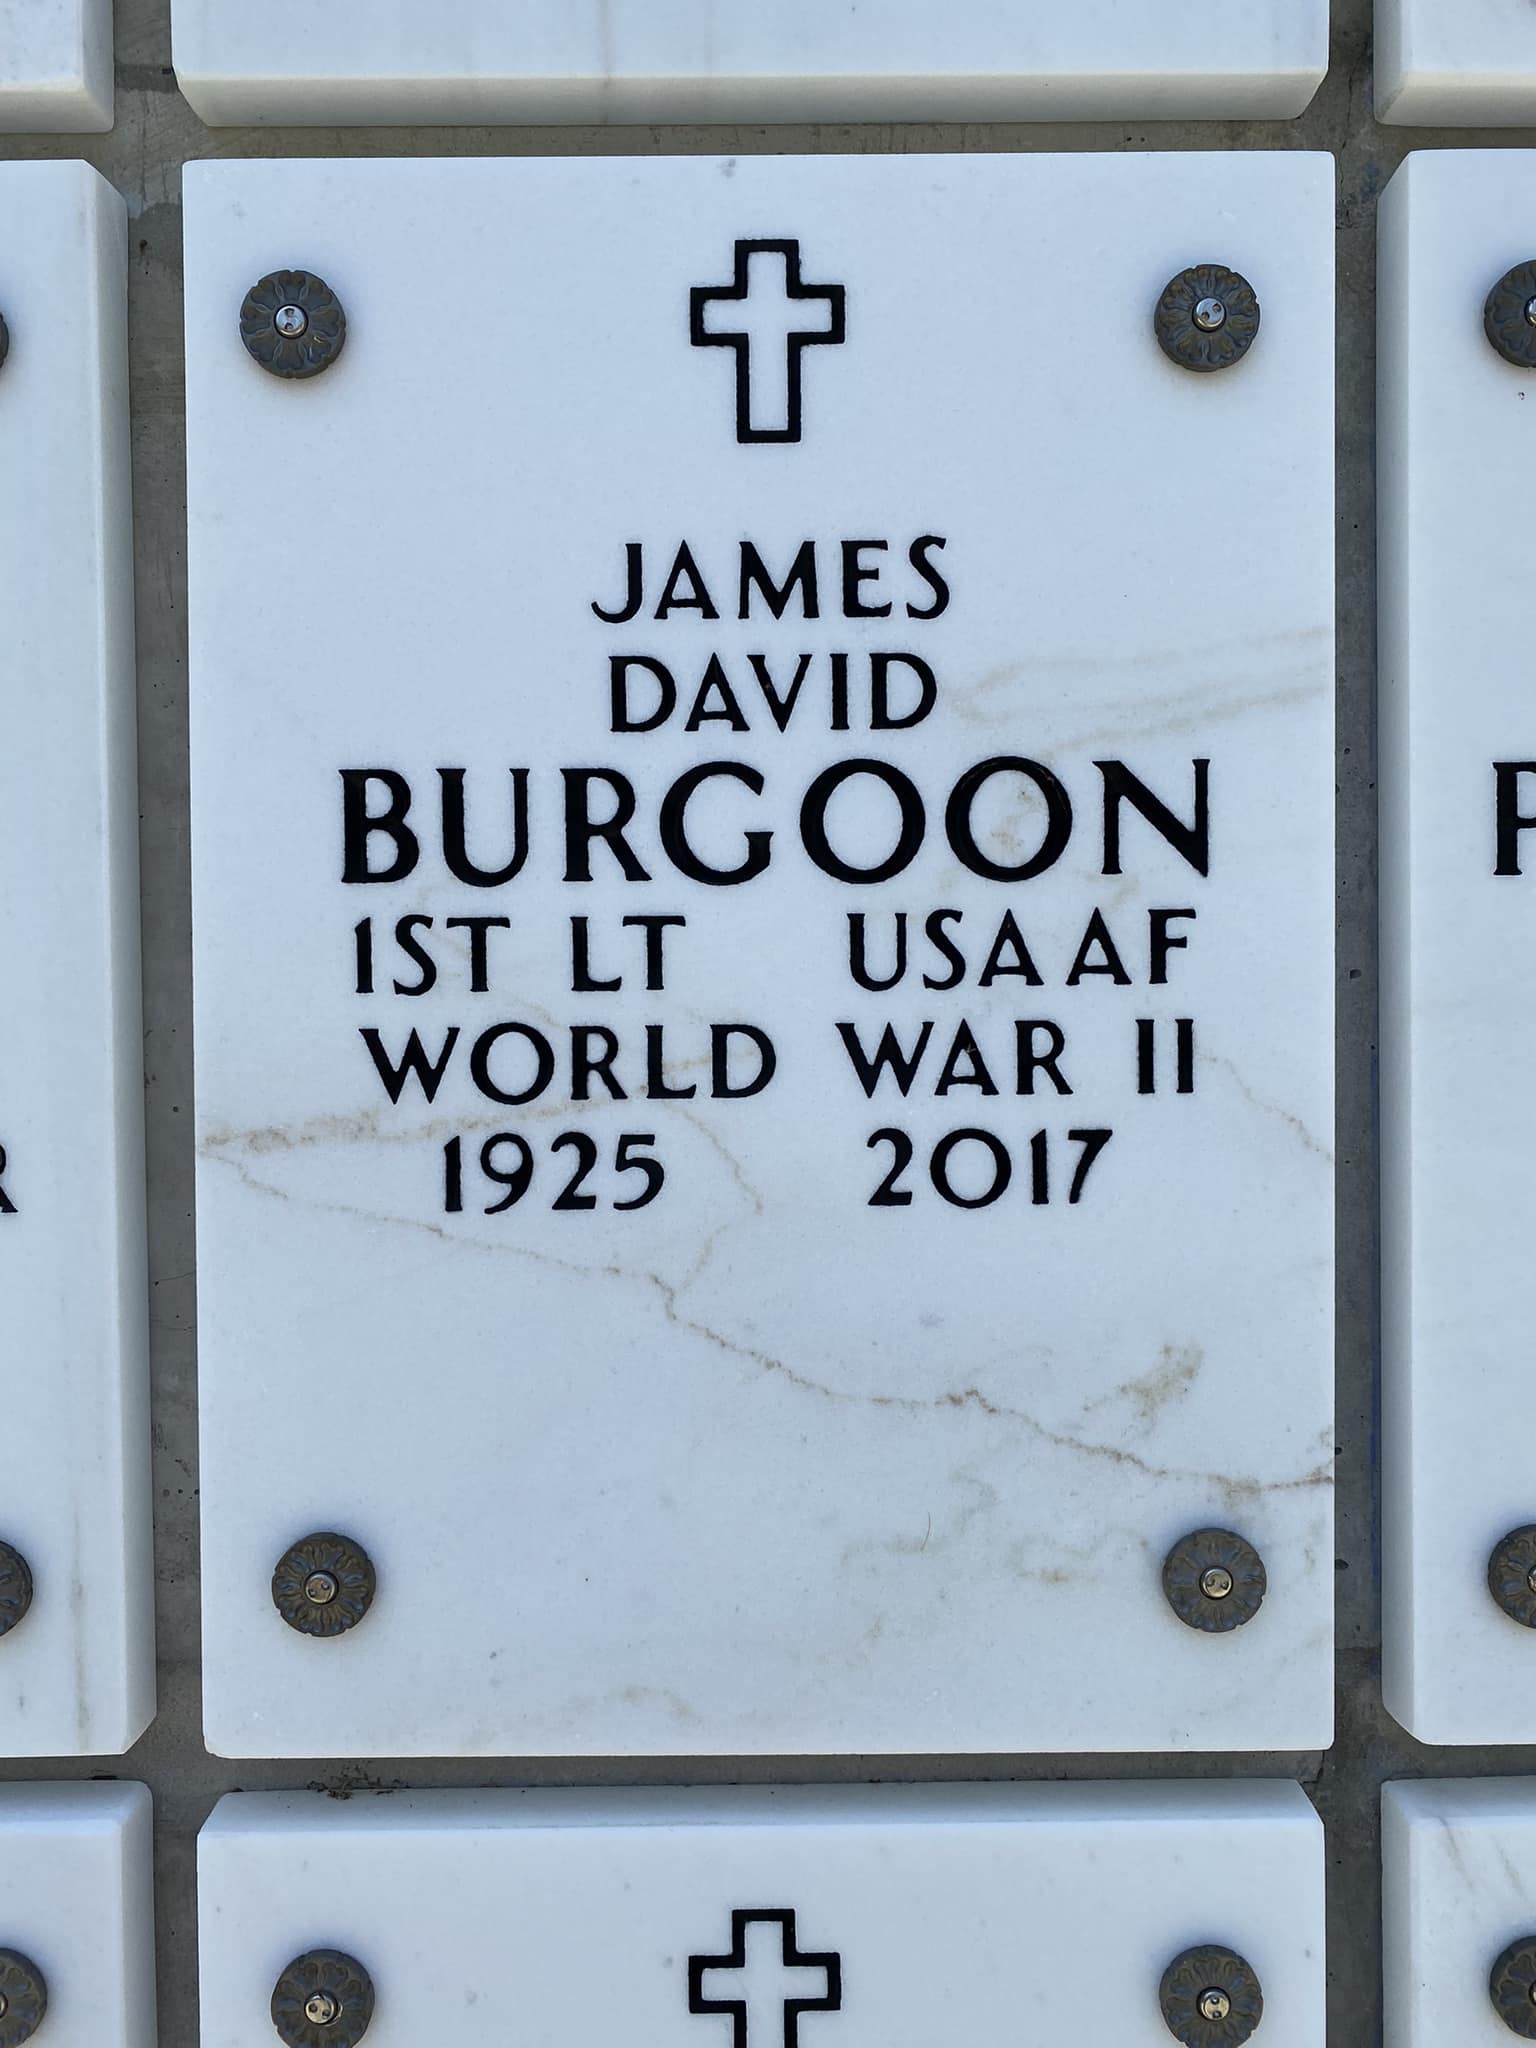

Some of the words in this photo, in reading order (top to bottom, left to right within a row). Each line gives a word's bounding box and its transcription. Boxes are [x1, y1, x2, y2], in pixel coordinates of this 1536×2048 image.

[590, 534, 951, 624] JAMES
[608, 651, 939, 733] DAVID
[338, 755, 1212, 888] BURGOON
[354, 914, 511, 997] 1ST
[569, 915, 687, 993] LT
[846, 906, 1197, 992] USAAF
[358, 1021, 777, 1106] WORLD
[834, 1018, 1074, 1099] WAR
[1135, 1018, 1194, 1097] II
[443, 1130, 665, 1215] 1925
[866, 1127, 1113, 1210] 2017
